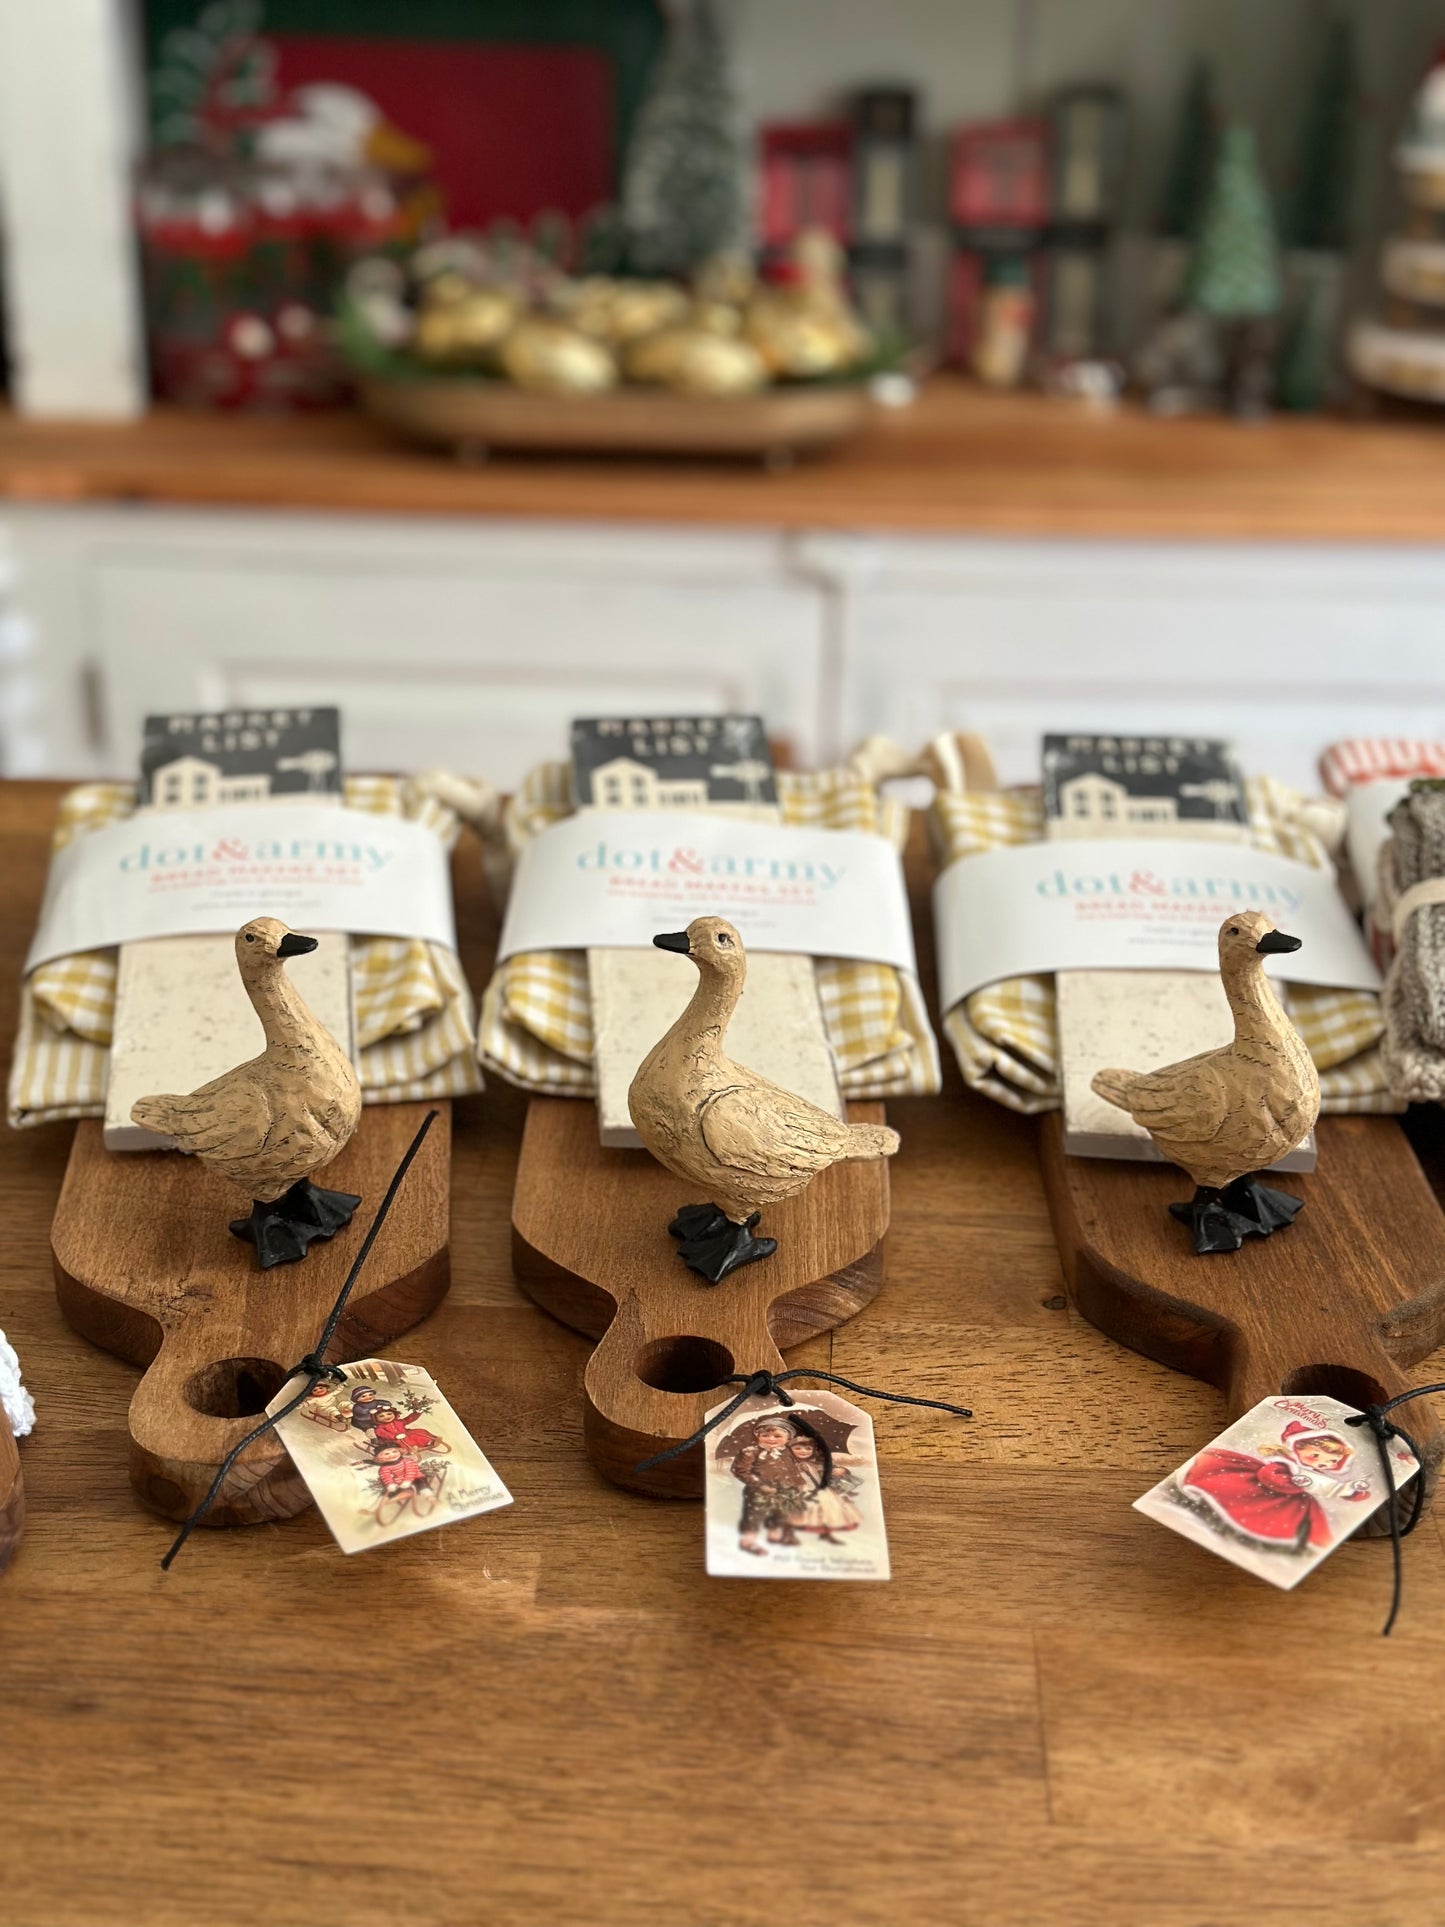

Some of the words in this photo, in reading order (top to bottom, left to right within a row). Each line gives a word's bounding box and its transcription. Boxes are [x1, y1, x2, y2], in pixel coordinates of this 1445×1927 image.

[202, 728, 280, 753] LIST
[633, 735, 709, 756] LIST
[1102, 756, 1180, 776] LIST
[118, 838, 393, 873] dot&army
[576, 841, 847, 890] dot&army
[1036, 869, 1304, 910] dot&army
[458, 1485, 491, 1498] Merry
